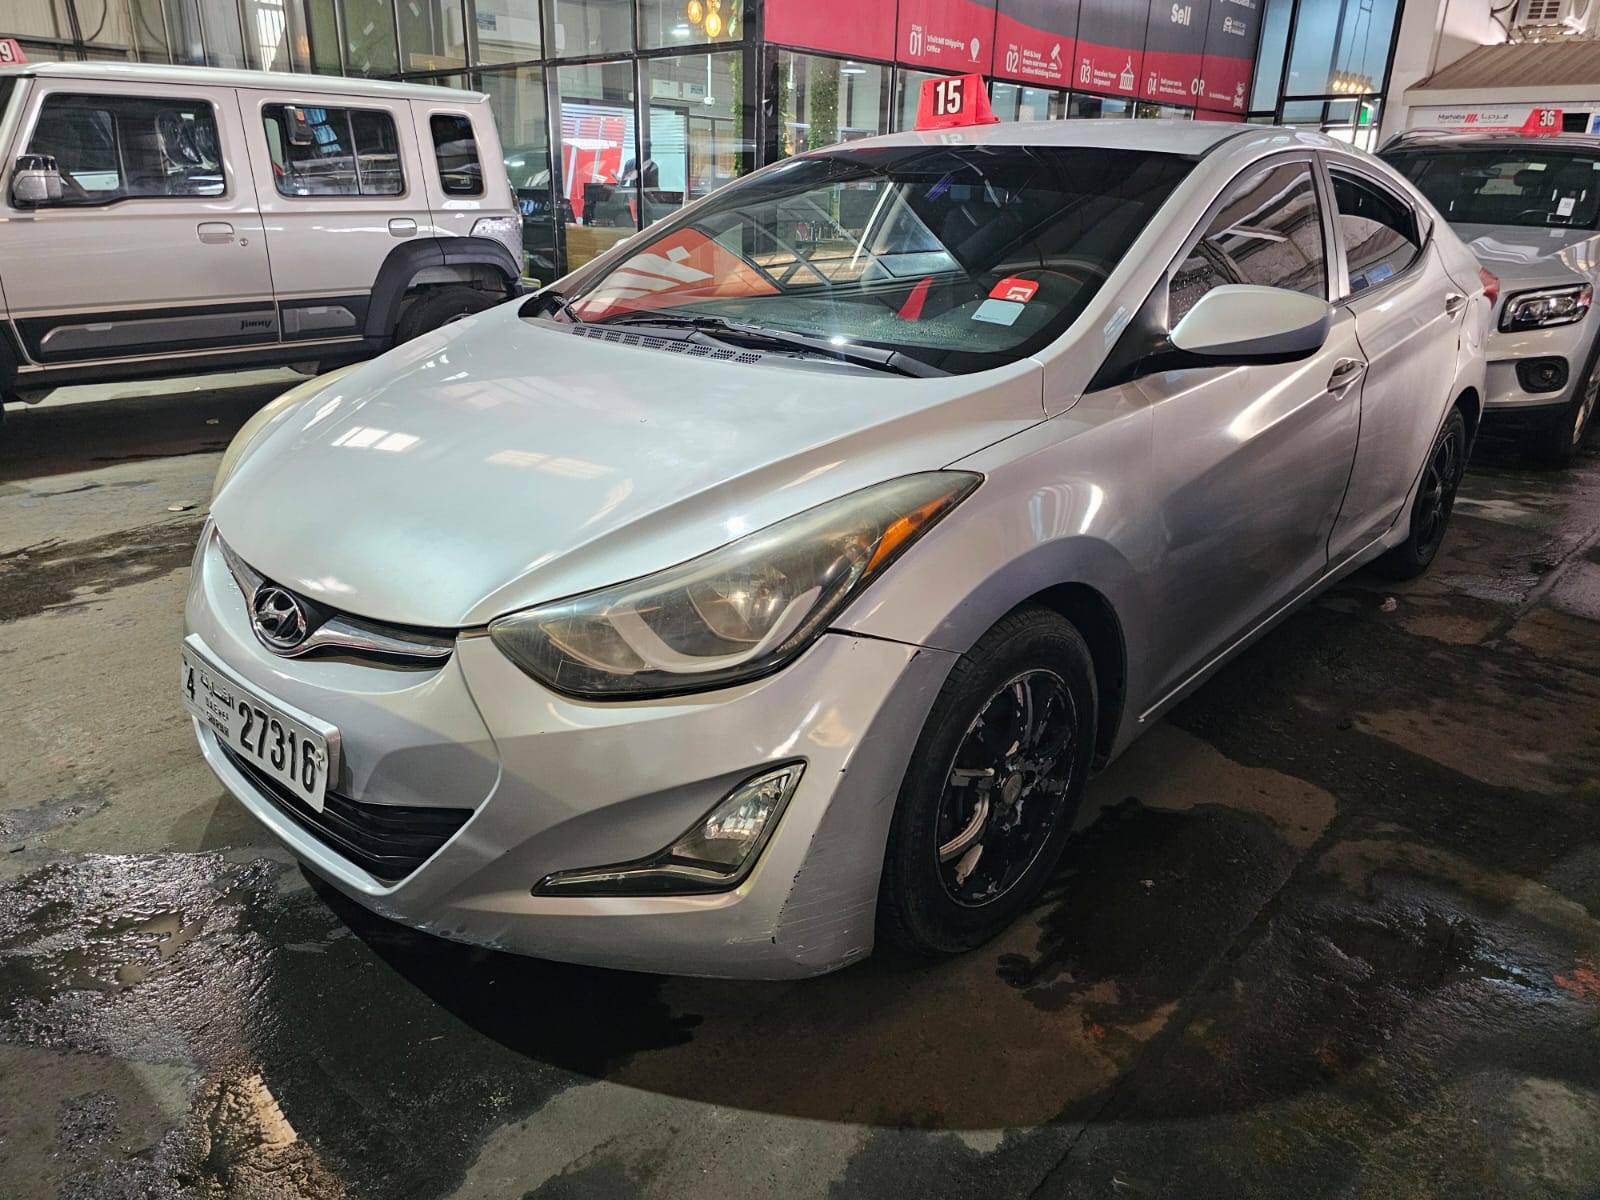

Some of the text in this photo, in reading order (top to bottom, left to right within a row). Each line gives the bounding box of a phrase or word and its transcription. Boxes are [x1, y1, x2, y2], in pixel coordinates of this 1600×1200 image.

[1170, 3, 1191, 26] Sell
[909, 31, 922, 56] 01
[1006, 51, 1019, 73] 02
[1080, 64, 1091, 84] 03
[936, 80, 962, 115] 15
[1147, 77, 1157, 96] 04
[1191, 78, 1205, 96] OR
[1539, 110, 1555, 127] 36
[240, 320, 272, 330] Jimny
[186, 666, 196, 701] 4
[238, 700, 316, 794] 27316
